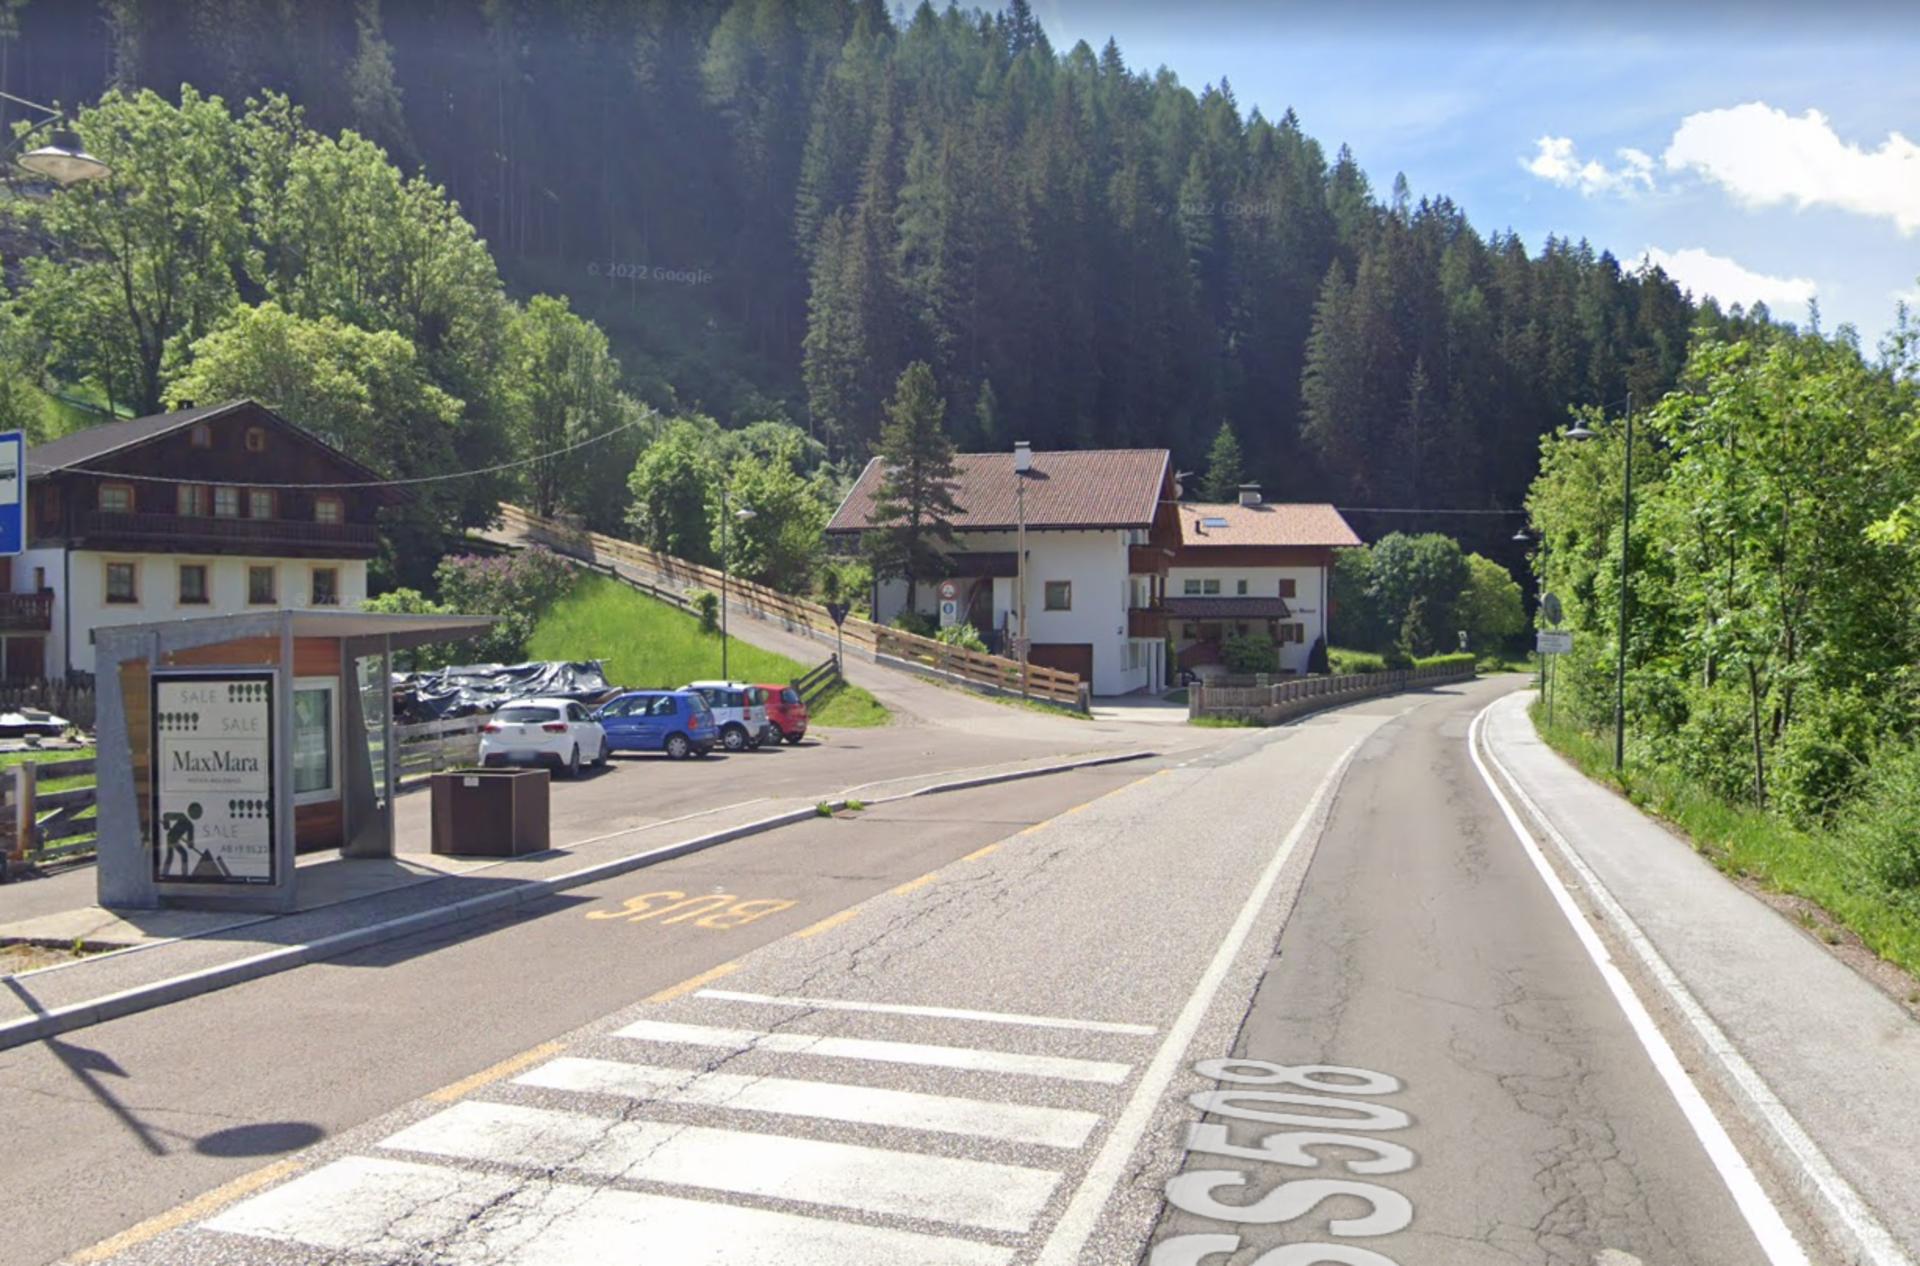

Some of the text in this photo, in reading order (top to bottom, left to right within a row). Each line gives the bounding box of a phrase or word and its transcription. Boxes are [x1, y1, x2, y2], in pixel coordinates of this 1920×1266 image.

[181, 689, 217, 704] SALE
[222, 717, 258, 731] SALE
[172, 750, 259, 772] MaxMara
[203, 825, 239, 839] SALE
[585, 891, 798, 929] BUS
